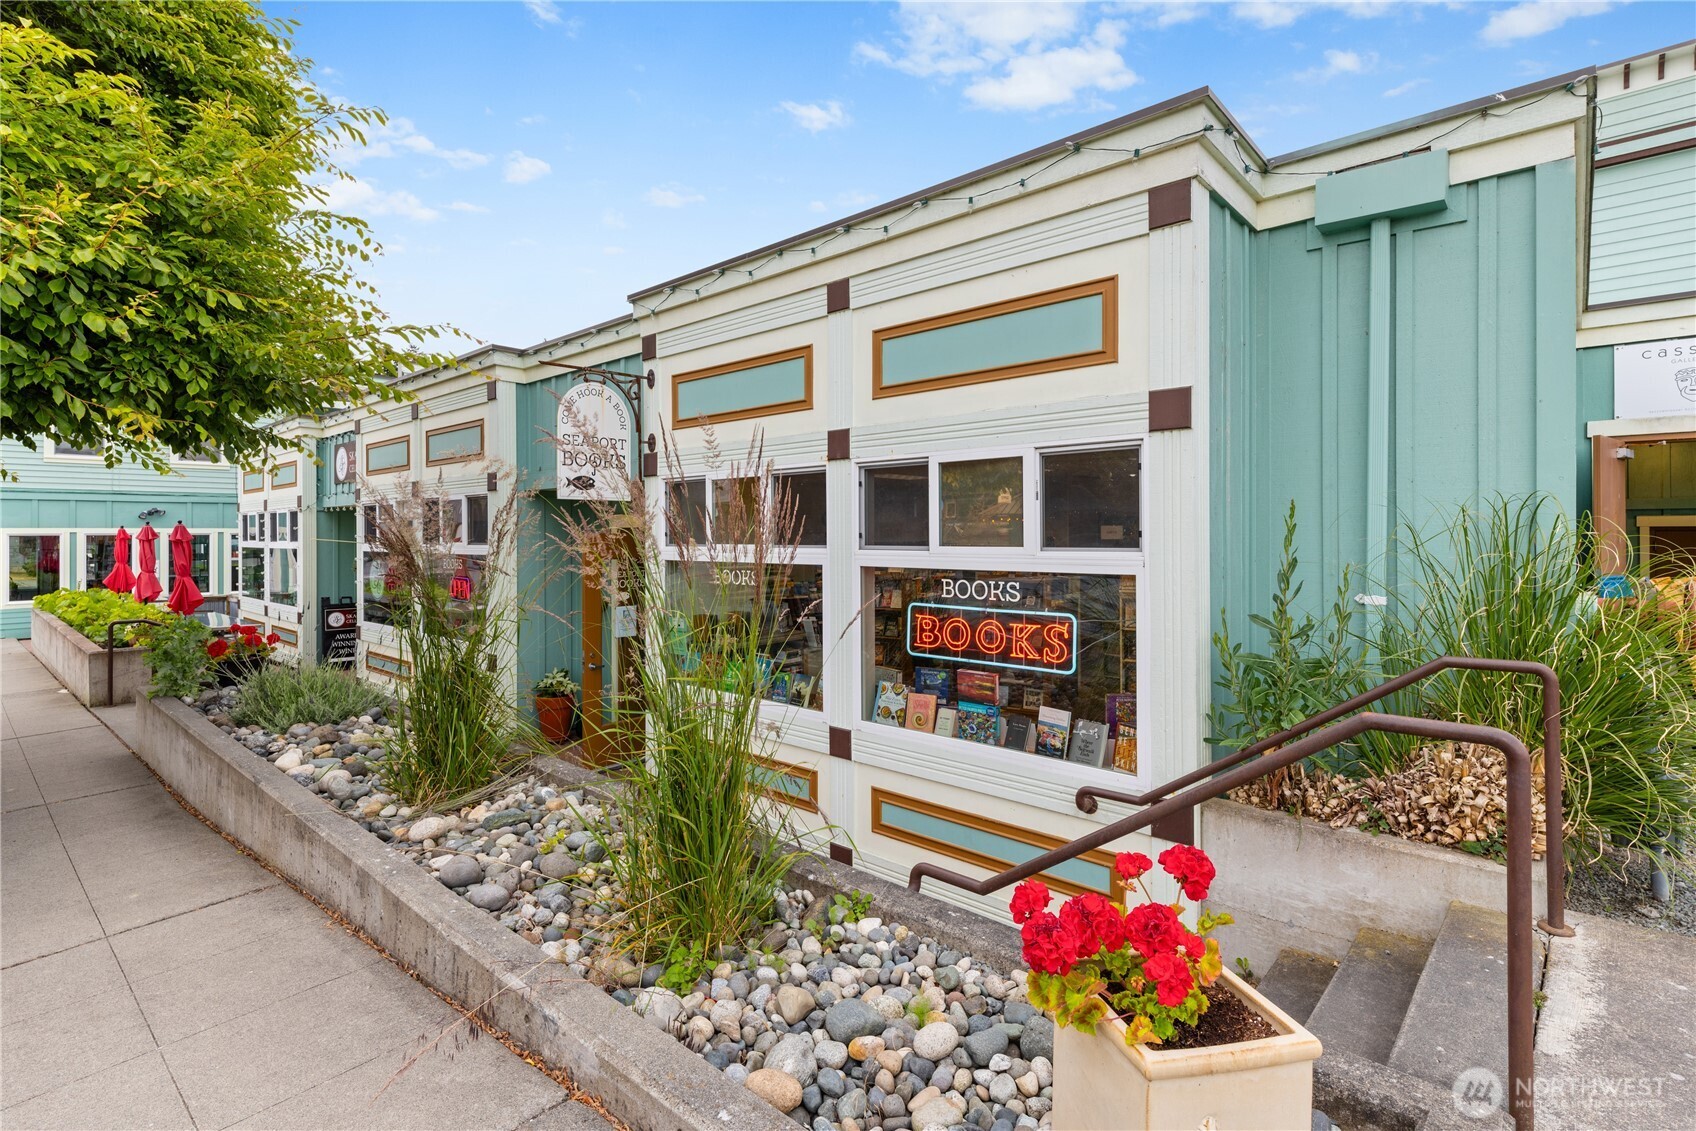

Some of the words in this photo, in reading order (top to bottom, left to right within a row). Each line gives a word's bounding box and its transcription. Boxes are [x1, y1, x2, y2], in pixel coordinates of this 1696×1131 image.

[561, 395, 578, 425] COE
[576, 388, 604, 399] HOOK
[605, 395, 612, 404] A
[612, 402, 627, 431] BOOK
[941, 578, 1021, 602] BOOKS
[914, 613, 1069, 664] BOOKS
